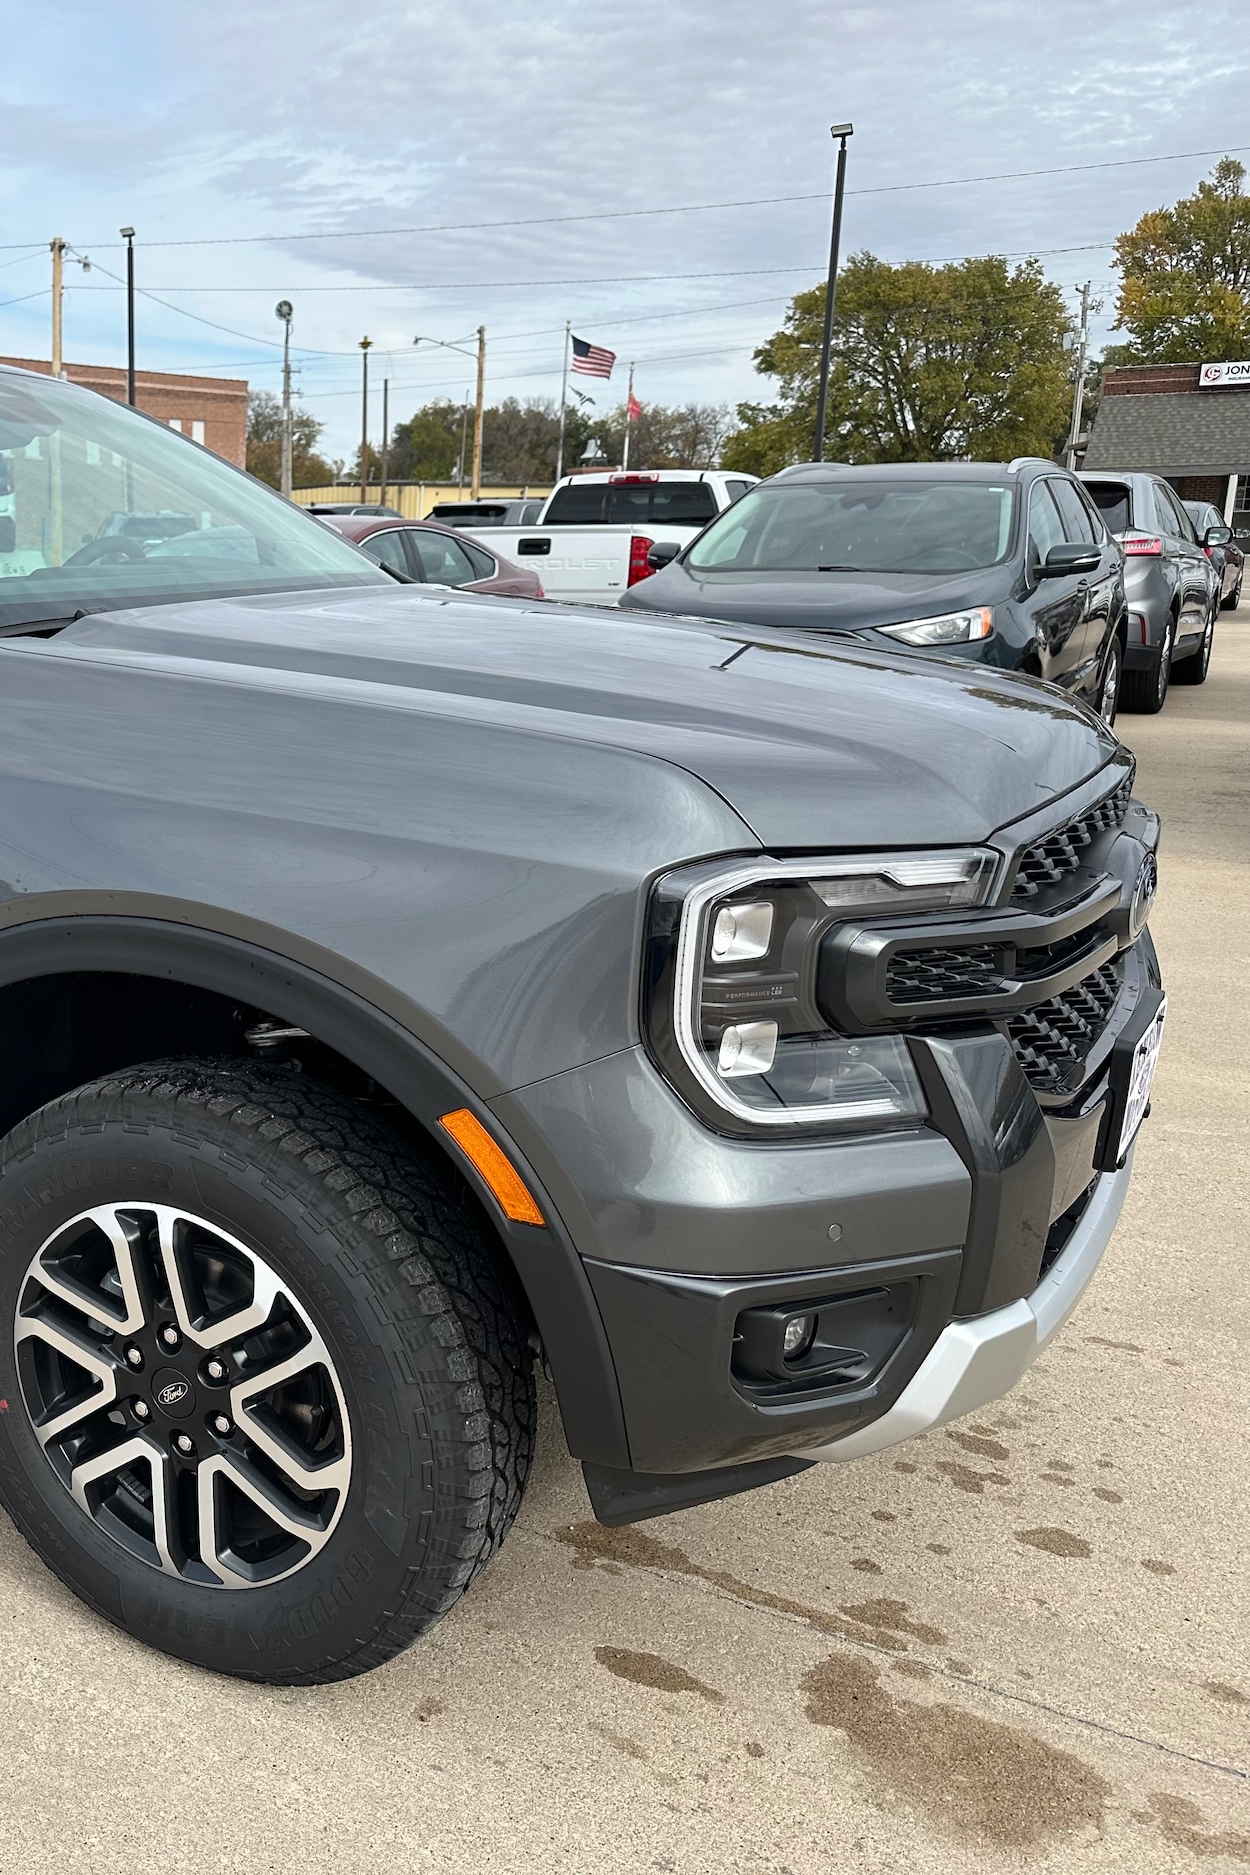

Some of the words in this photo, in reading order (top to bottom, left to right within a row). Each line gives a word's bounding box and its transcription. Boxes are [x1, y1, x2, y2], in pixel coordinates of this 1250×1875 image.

[725, 990, 770, 999] PERFORMANCE
[771, 988, 783, 996] LED
[276, 1236, 376, 1384] TERRITORY
[162, 1385, 184, 1403] Ford
